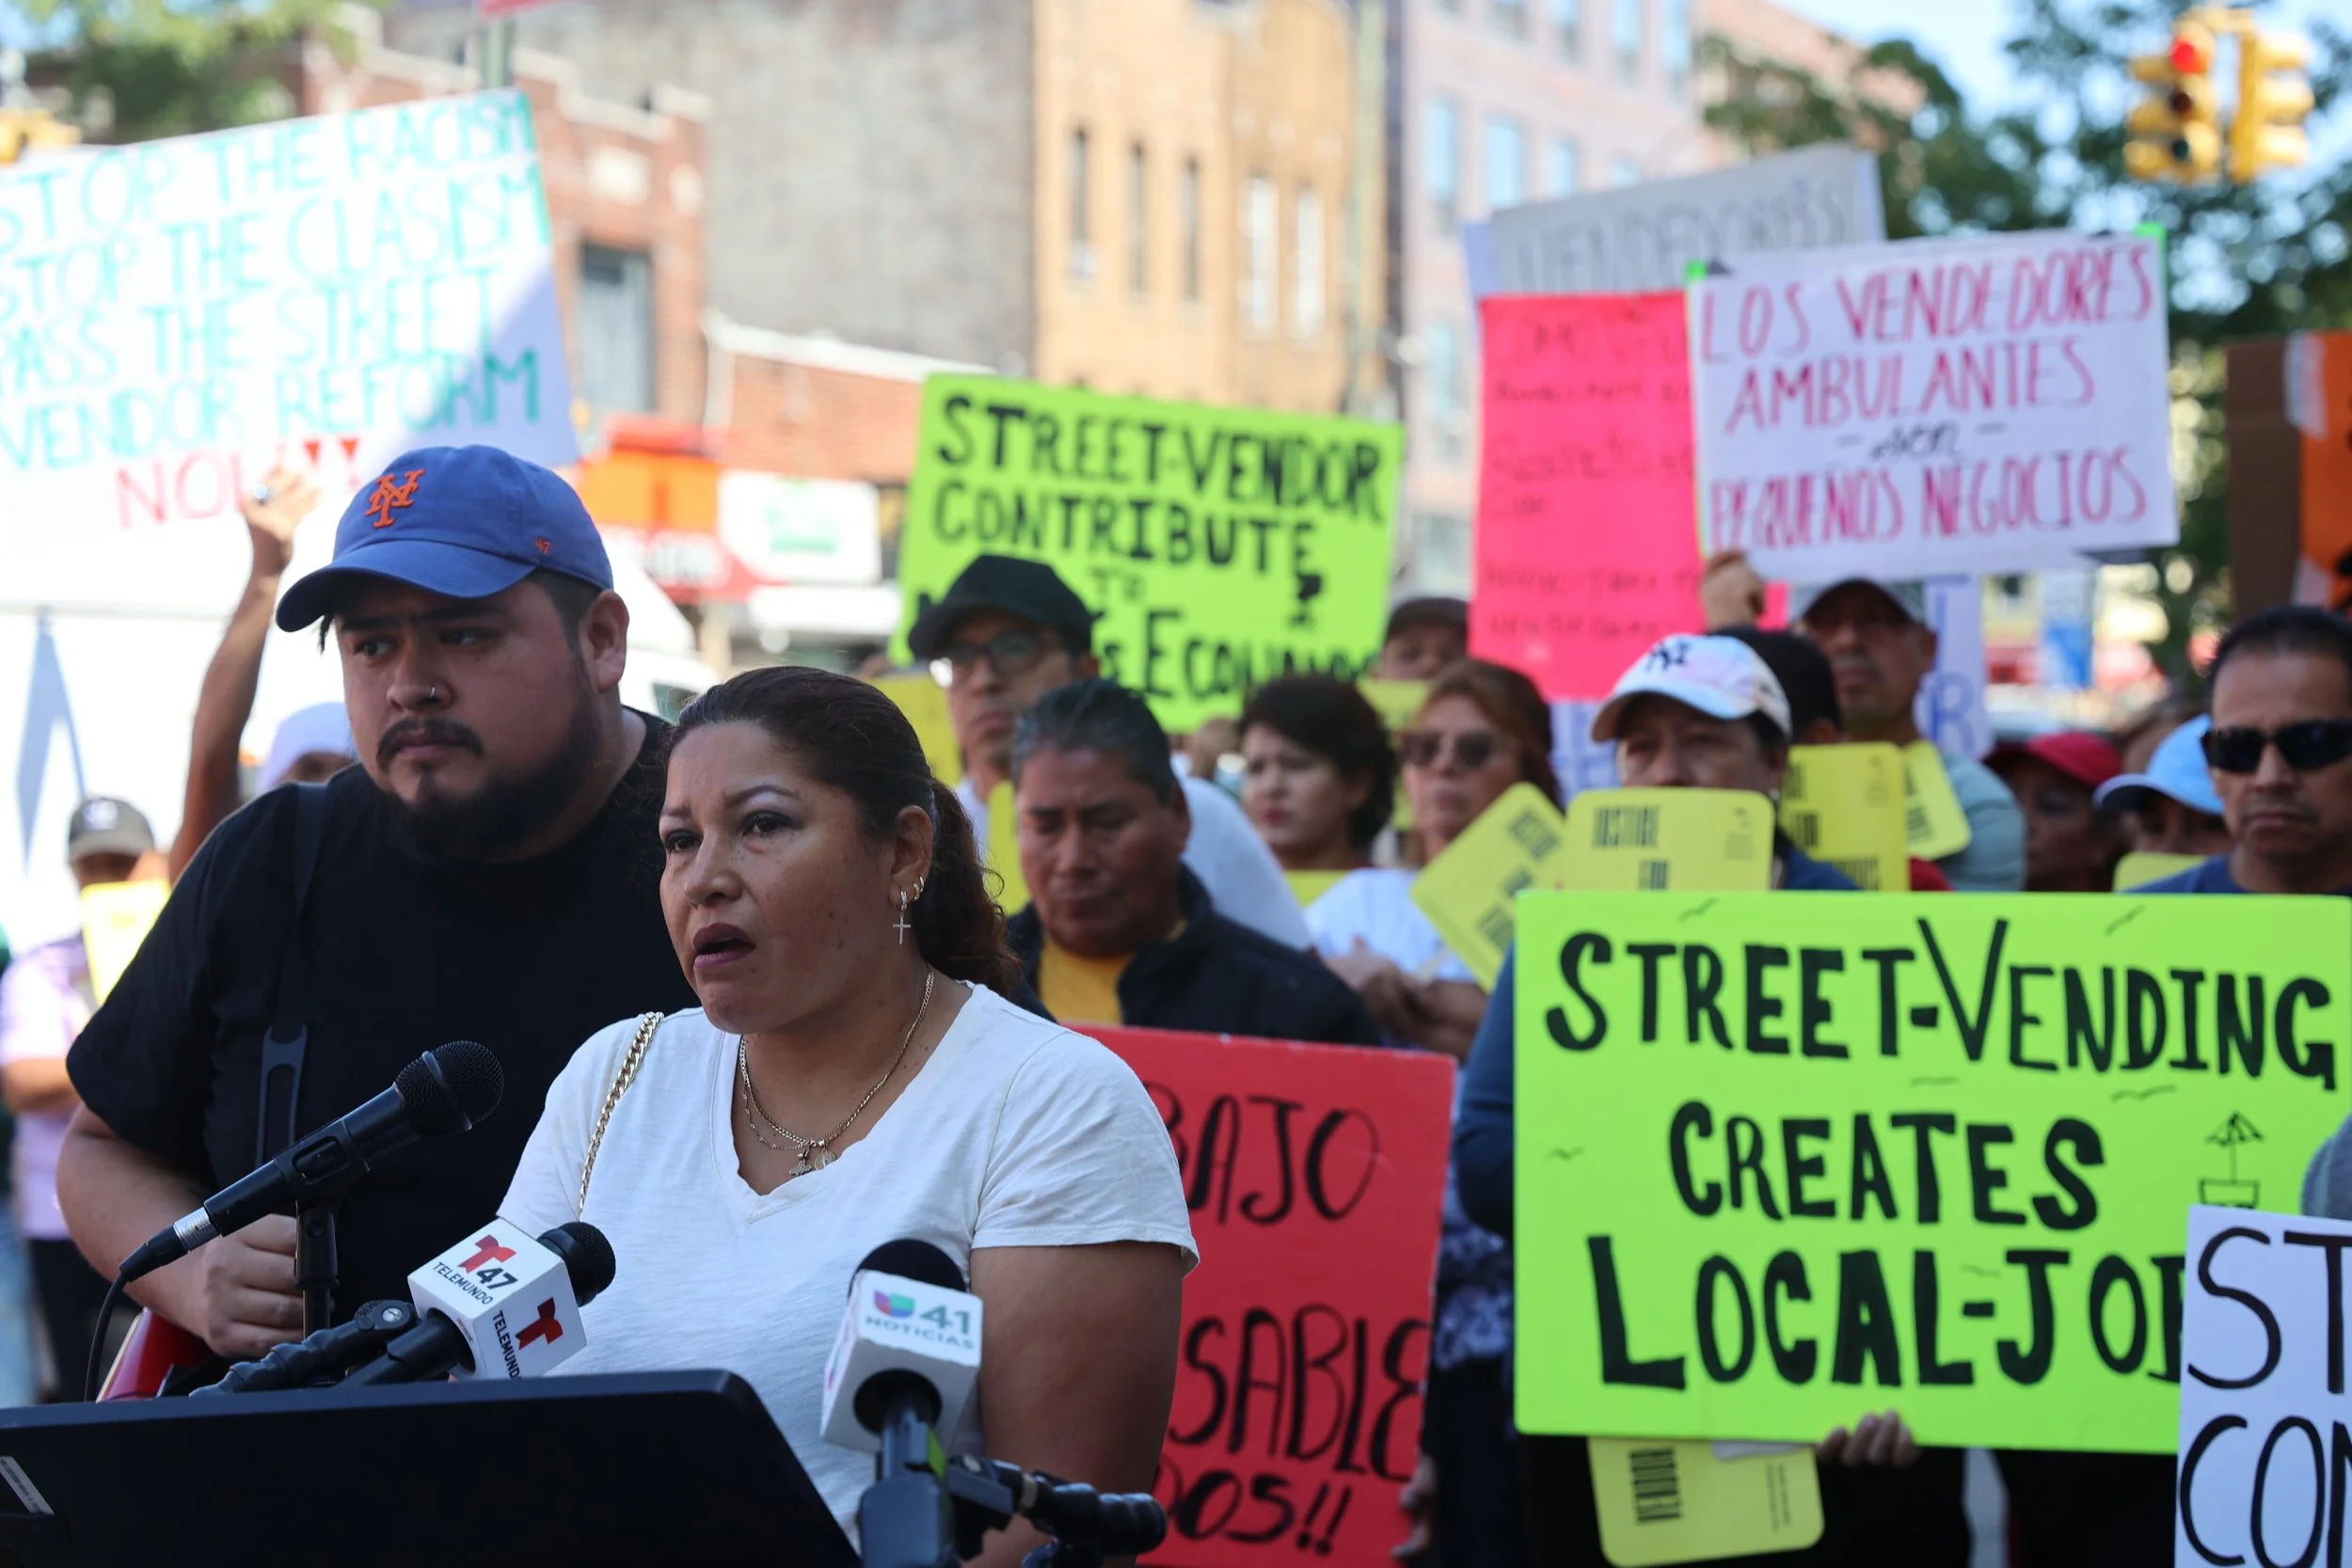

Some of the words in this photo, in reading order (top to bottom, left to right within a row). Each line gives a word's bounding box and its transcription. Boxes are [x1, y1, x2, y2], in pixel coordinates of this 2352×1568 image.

[196, 120, 327, 202] THE
[342, 92, 536, 182] RACISM
[158, 208, 270, 295] THE
[138, 292, 256, 374] THE
[278, 263, 501, 369] STREET
[1700, 280, 1813, 365] LOS
[1836, 244, 2153, 342] VENDEDORES
[0, 374, 243, 472] VENDOR
[273, 346, 541, 438] REFORM
[1724, 336, 2095, 435] AMBULANTES
[938, 395, 1386, 523] STREET-VENDOR
[1921, 444, 2147, 538] NEGOCIOS
[933, 481, 1317, 574] CONTRIBUTE
[1544, 917, 2337, 1091] STREET-VENDING
[1667, 1099, 2106, 1231] CREATES
[433, 1261, 495, 1306] TELEMUNDO
[475, 1266, 519, 1291] 47
[919, 1304, 972, 1336] 41
[491, 1309, 523, 1380] TELEMUND
[864, 1314, 976, 1351] NOTICIAS
